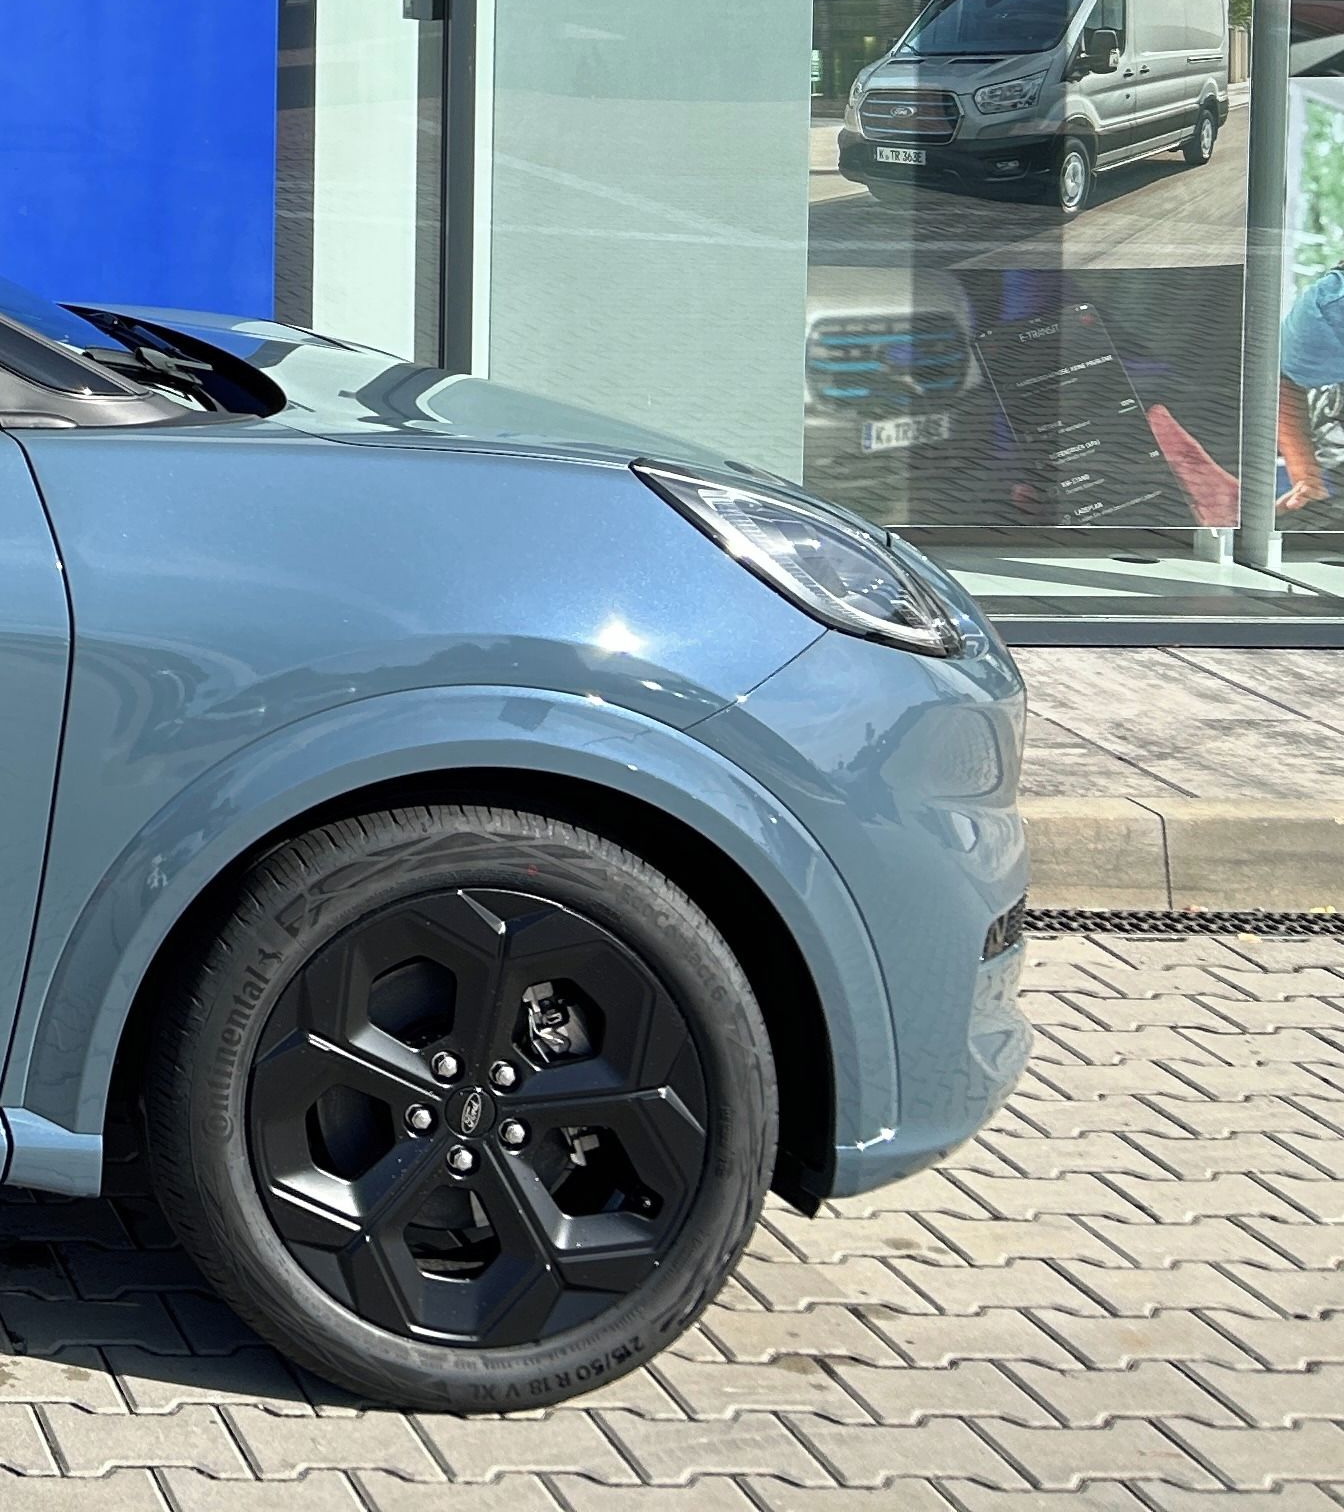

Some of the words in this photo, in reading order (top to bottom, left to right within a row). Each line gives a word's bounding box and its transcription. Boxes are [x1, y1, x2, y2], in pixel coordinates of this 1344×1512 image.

[202, 964, 272, 1144] Continental
[555, 1373, 572, 1388] R
[576, 1335, 645, 1382] 215/50
